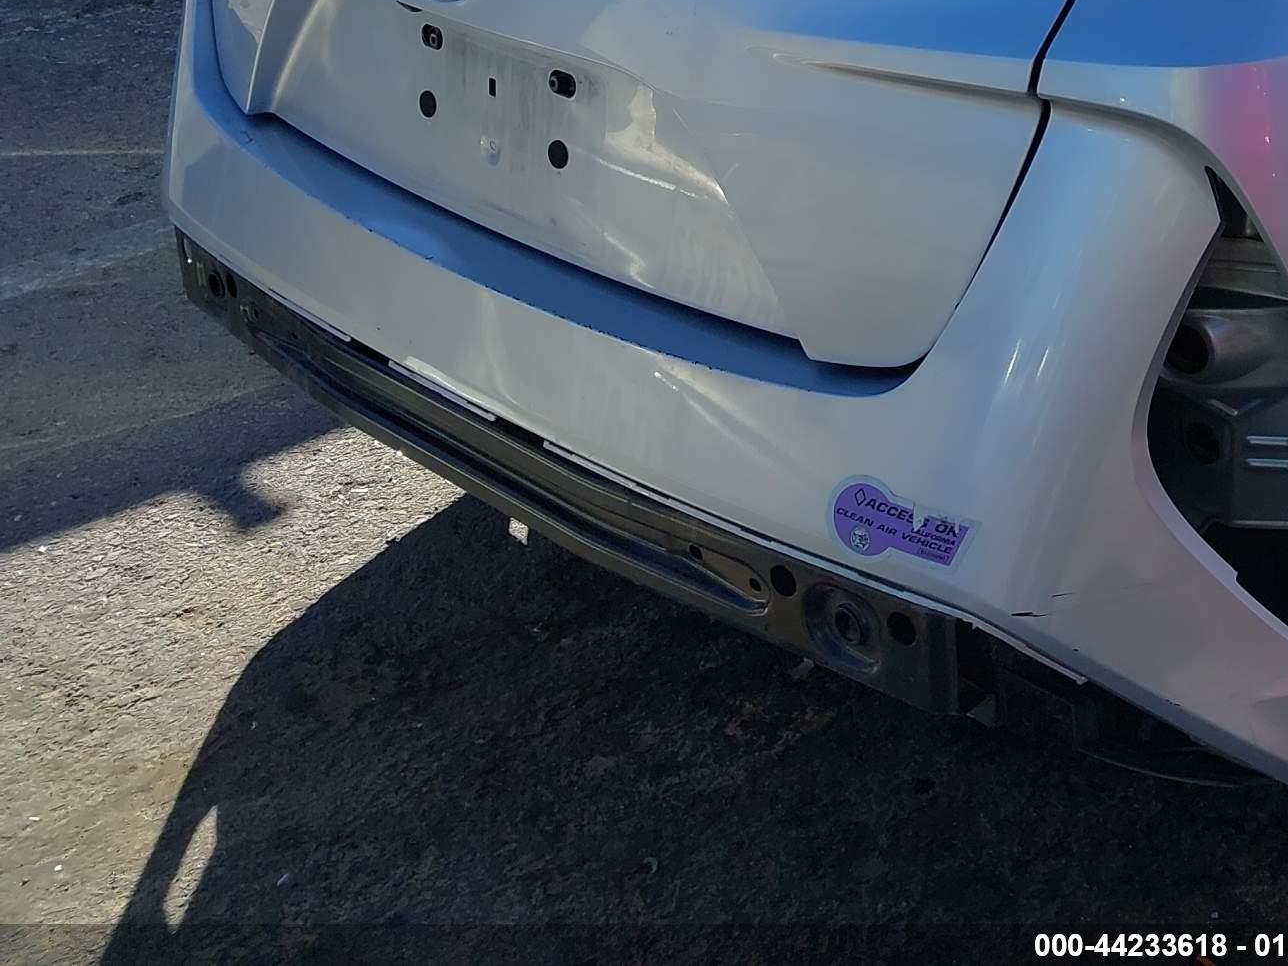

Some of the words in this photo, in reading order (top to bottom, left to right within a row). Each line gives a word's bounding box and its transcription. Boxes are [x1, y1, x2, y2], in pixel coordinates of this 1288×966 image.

[836, 507, 875, 527] CLEAN
[876, 523, 898, 537] AIR
[901, 533, 954, 554] VEHICLE
[934, 522, 962, 538] OK
